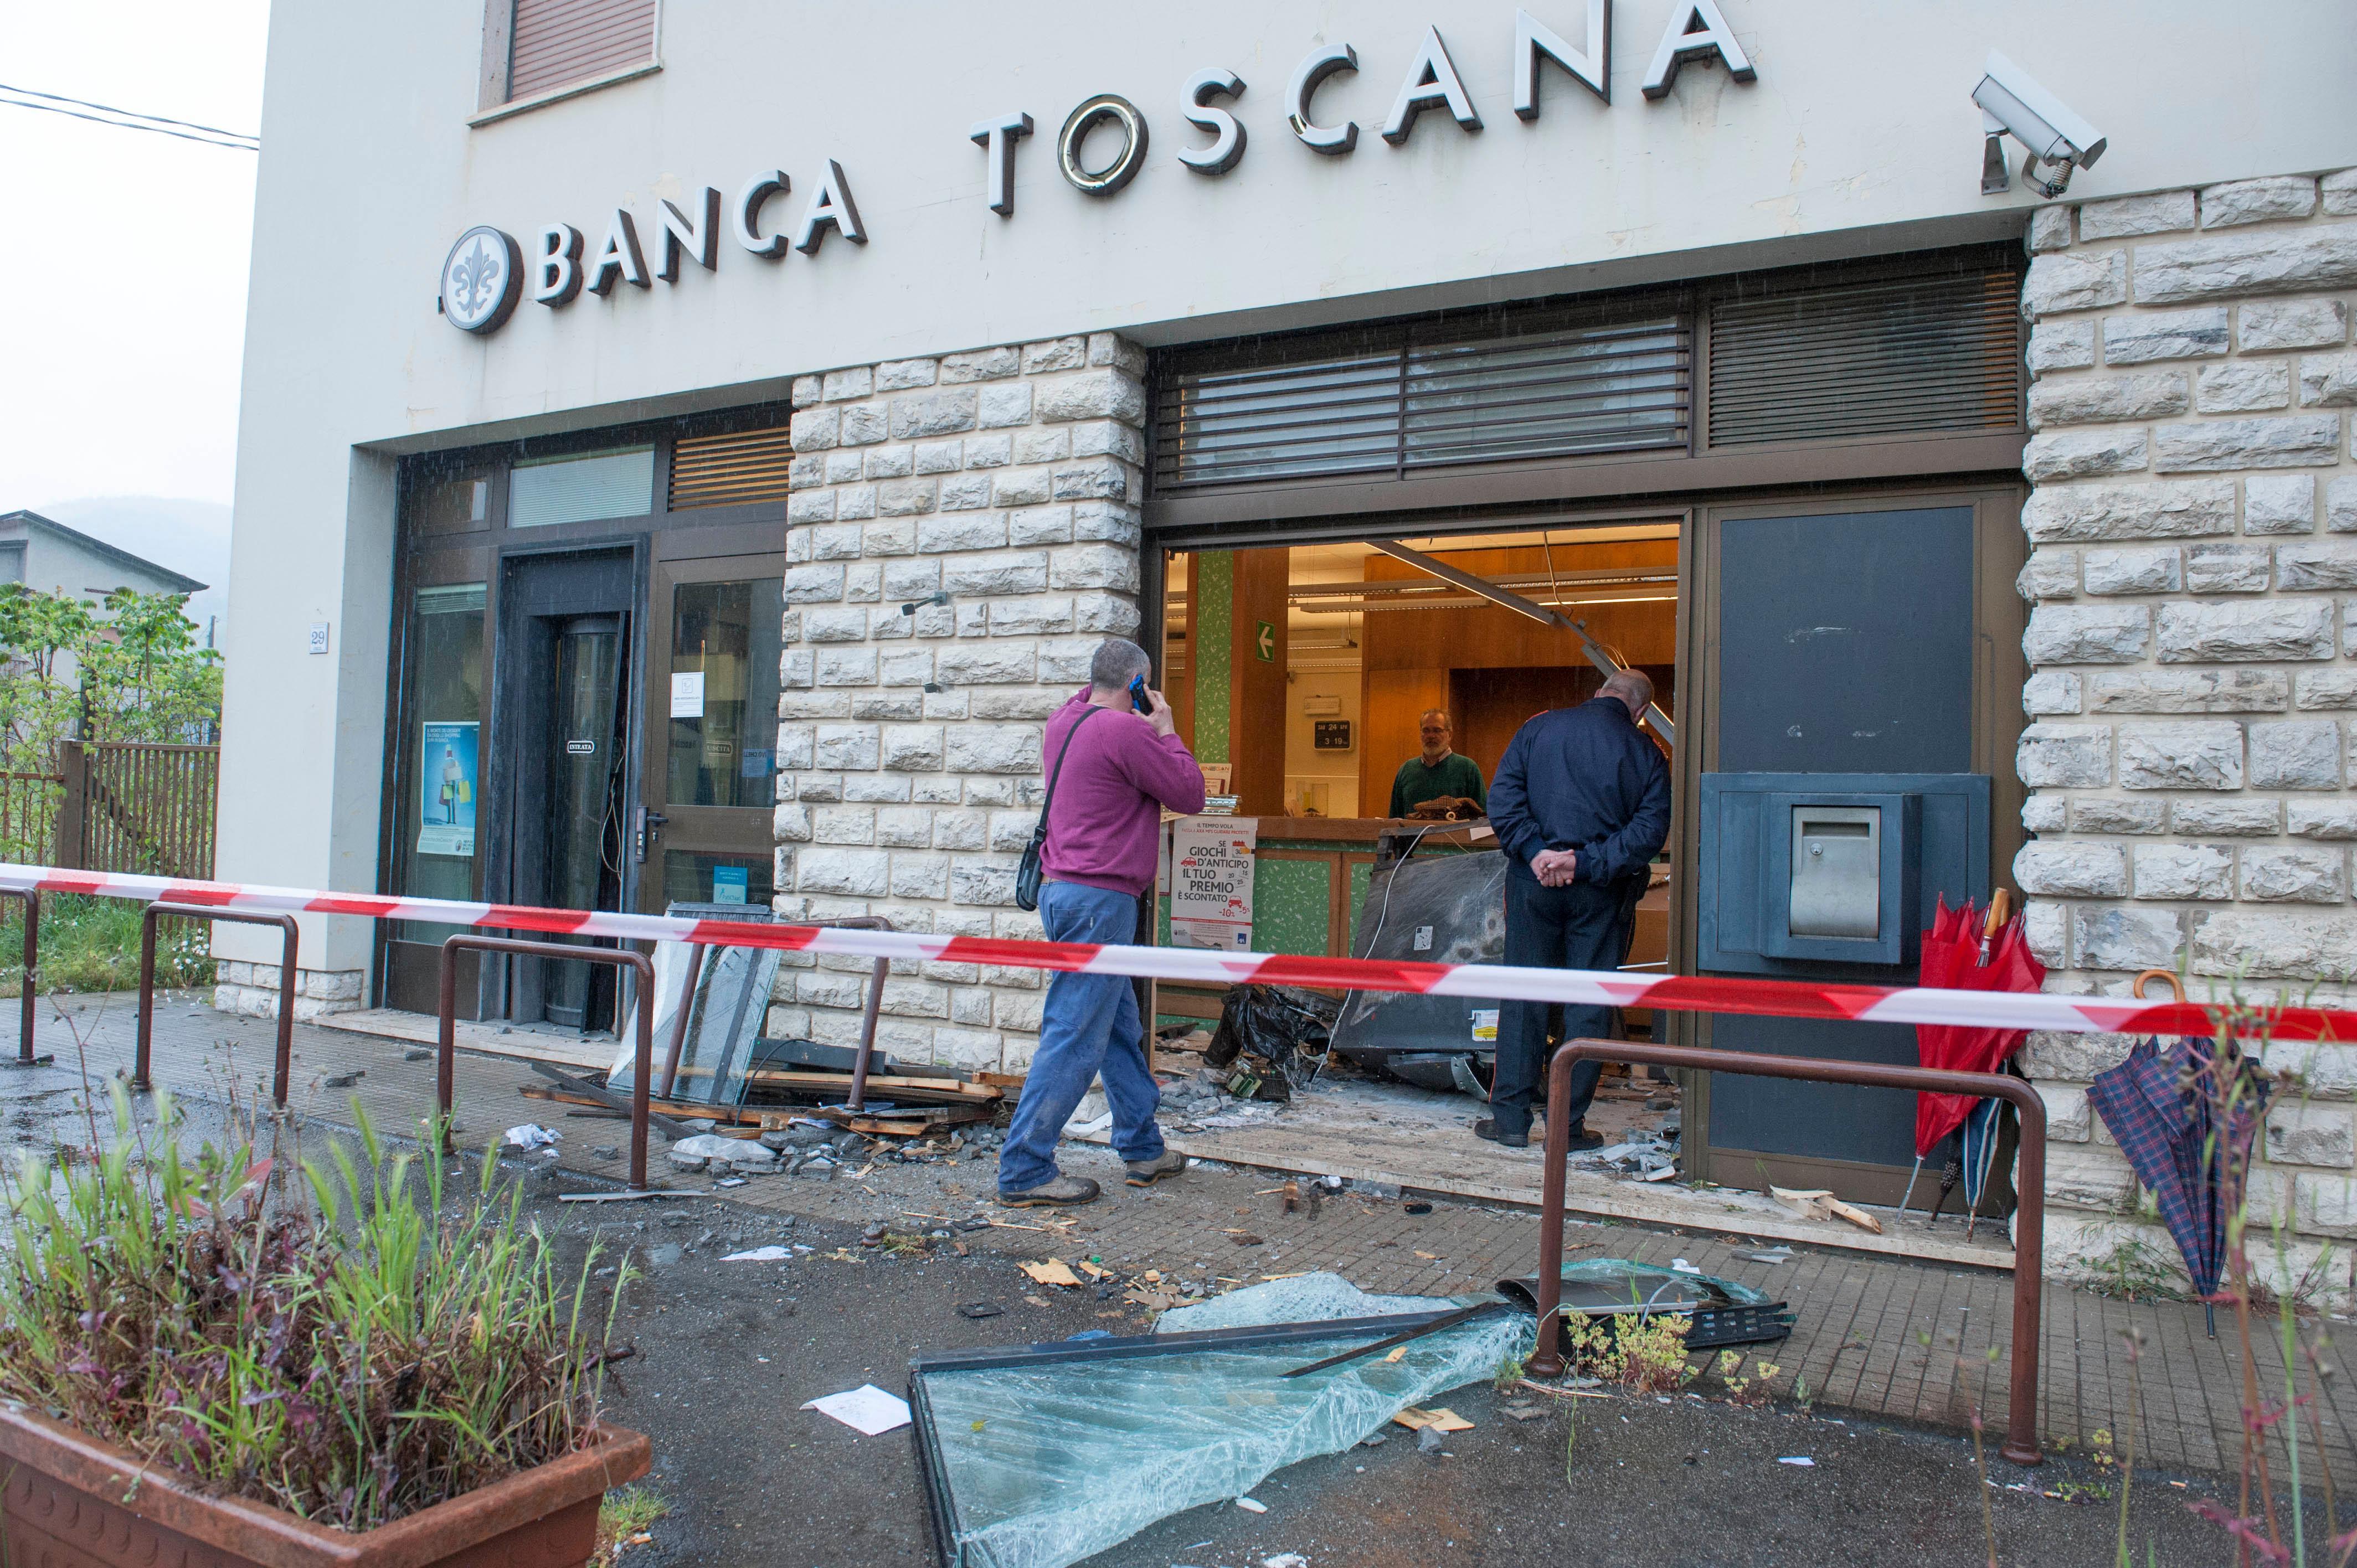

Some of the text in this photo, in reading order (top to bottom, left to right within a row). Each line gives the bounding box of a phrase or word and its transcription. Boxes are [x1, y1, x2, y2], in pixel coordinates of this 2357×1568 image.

[534, 0, 1758, 307] BANCA TOSCANA
[311, 631, 325, 644] 29
[1190, 847, 1226, 858] GIOCHI
[1197, 858, 1249, 869] D'ANTICIPO
[1182, 868, 1216, 879] IL TUO
[1190, 880, 1234, 893] PREMIO
[1178, 890, 1228, 902] È SCONTATO
